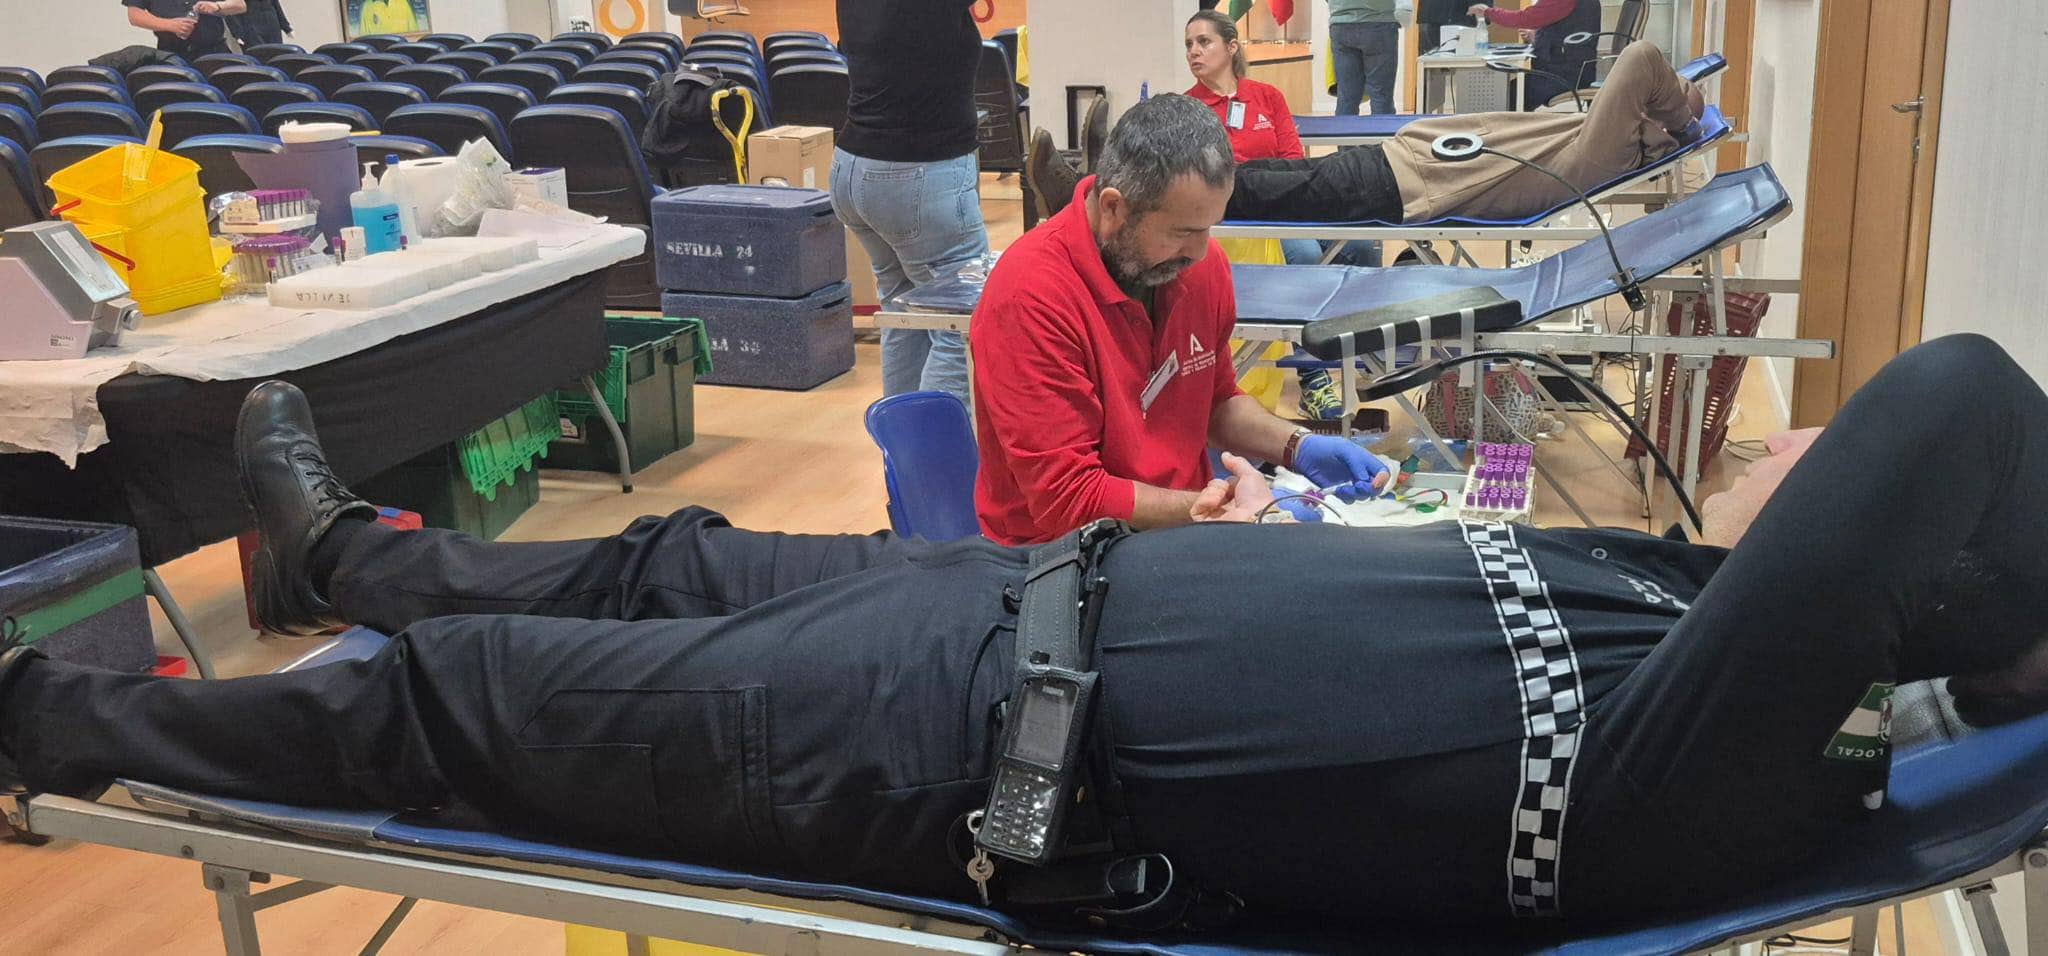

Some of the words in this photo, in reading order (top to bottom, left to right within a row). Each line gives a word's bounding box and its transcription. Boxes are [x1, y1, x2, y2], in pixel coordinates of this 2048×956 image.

[666, 242, 723, 258] SEVILLA
[736, 244, 753, 259] 24
[1837, 745, 1884, 758] LOCAL
